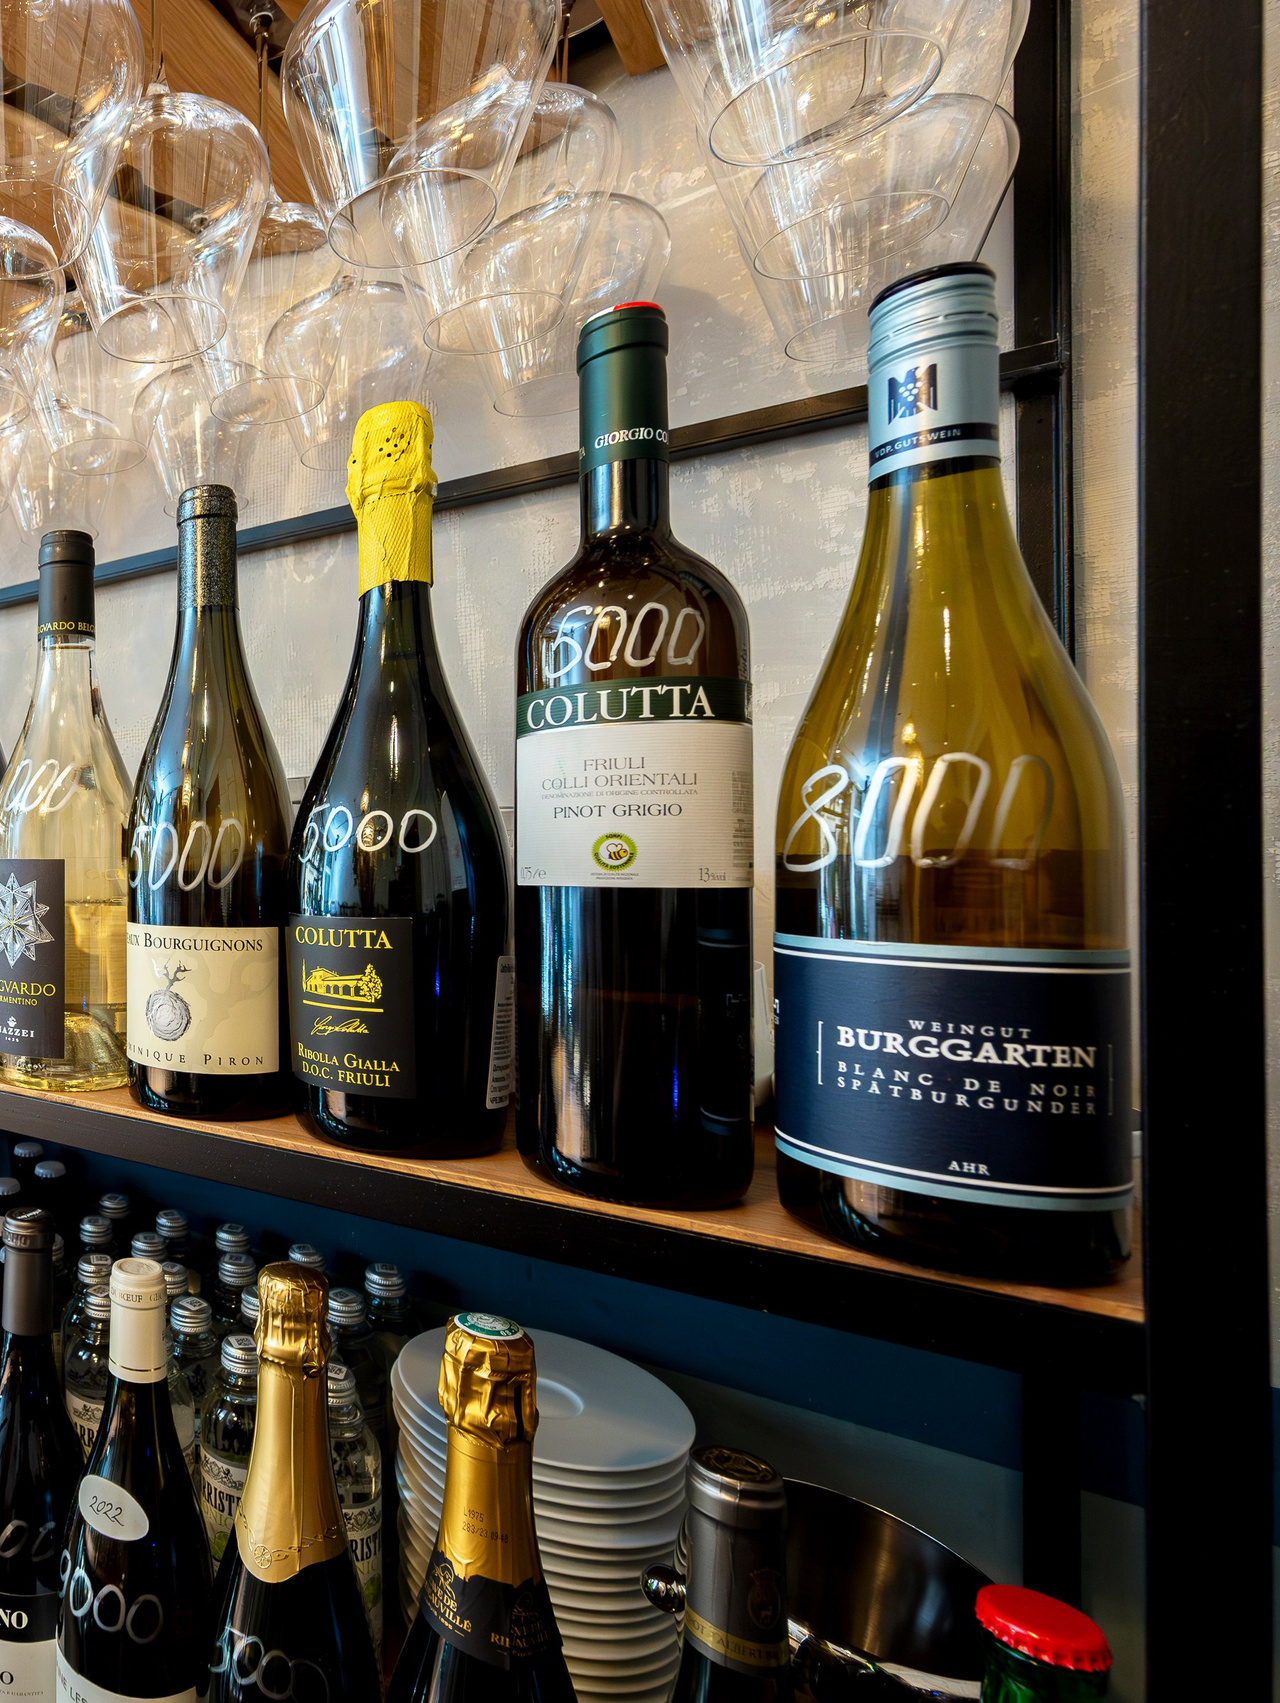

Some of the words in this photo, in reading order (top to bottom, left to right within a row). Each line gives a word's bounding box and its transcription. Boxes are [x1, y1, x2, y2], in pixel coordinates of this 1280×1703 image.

[595, 428, 654, 449] GIORGIO
[544, 602, 706, 681] 5000
[526, 684, 715, 729] COLUTTA
[583, 757, 646, 771] FRIULI
[542, 776, 589, 791] COLLI
[594, 772, 698, 787] ORIENTALI
[553, 805, 606, 819] PINOT
[612, 803, 683, 817] GRIGIO
[783, 752, 1055, 872] 8000
[298, 803, 438, 864] 5000
[128, 817, 245, 891] 5000
[144, 932, 263, 952] BOURGUIGNONS
[295, 926, 393, 949] COLUTTA
[909, 1019, 1032, 1039] WEINGUT
[203, 1053, 264, 1066] PIRON
[836, 1025, 1098, 1070] BURGGARTEN
[302, 1060, 334, 1080] D.O.C.
[337, 1070, 391, 1088] FRIULI
[838, 1061, 933, 1086] BLANC
[964, 1078, 1002, 1094] DE
[1030, 1083, 1097, 1098] NOIR
[837, 1076, 1097, 1116] SPÄTBURGUNDER
[948, 1160, 990, 1176] AHR
[89, 1494, 125, 1527] 2022
[463, 1506, 485, 1523] L1975
[462, 1521, 489, 1539] 283/23
[59, 1549, 164, 1644] 9000
